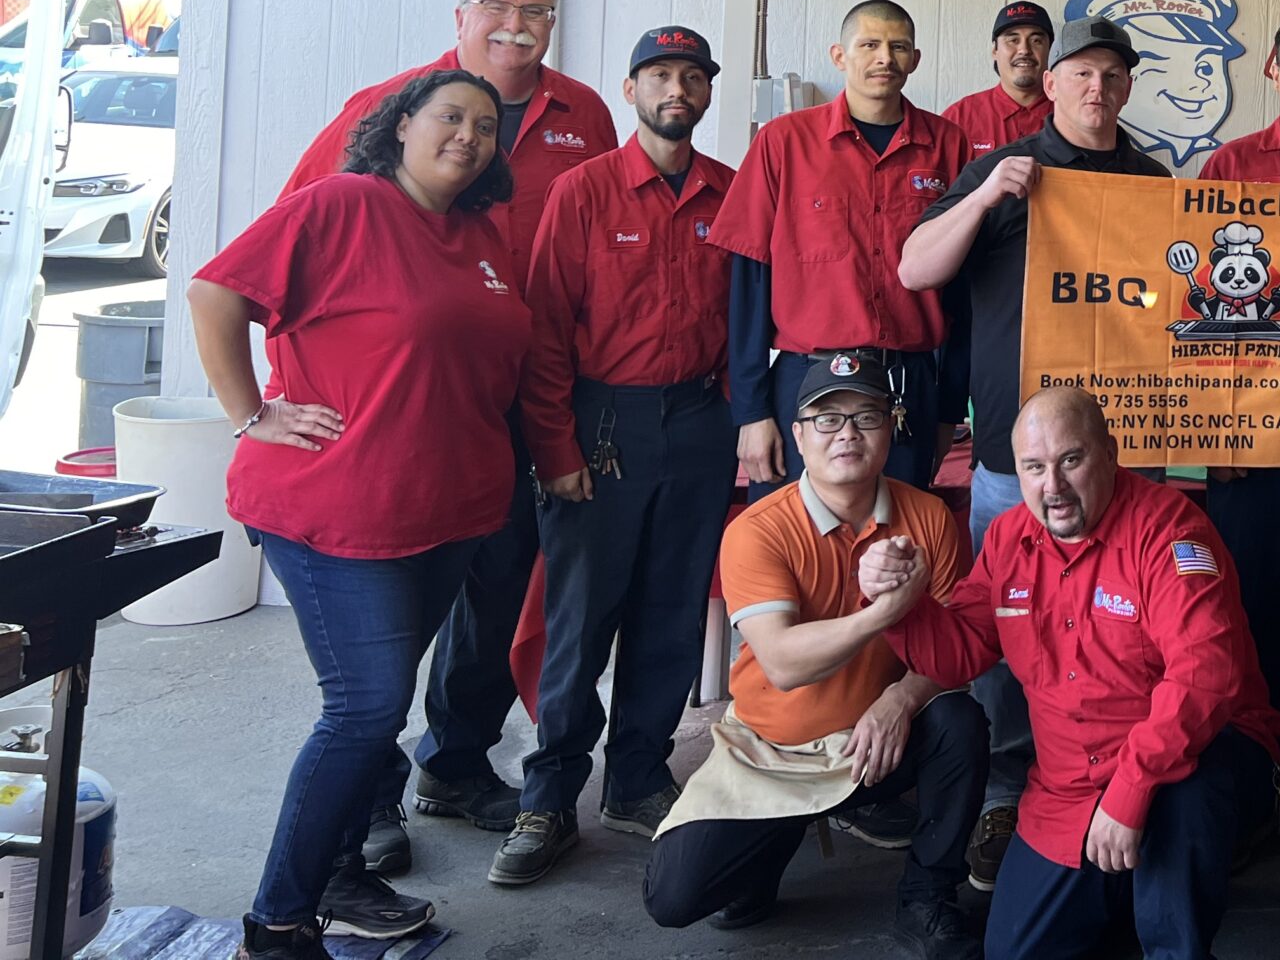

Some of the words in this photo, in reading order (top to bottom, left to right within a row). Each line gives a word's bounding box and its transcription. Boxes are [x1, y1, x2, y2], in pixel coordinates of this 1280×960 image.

[1122, 1, 1152, 14] Mr.
[1051, 271, 1147, 309] BBQ
[1171, 343, 1240, 358] HIBACHI
[1040, 374, 1085, 388] Book
[1114, 394, 1143, 408] 735
[1148, 394, 1188, 408] 5556
[1153, 414, 1175, 428] NJ
[1180, 414, 1204, 428] SC
[1208, 414, 1233, 428] NC
[1237, 414, 1257, 428] FL
[1123, 435, 1138, 449] IL
[1143, 435, 1162, 449] IN
[1166, 435, 1192, 449] OH
[1198, 435, 1219, 449] WI
[1224, 435, 1254, 449] MN
